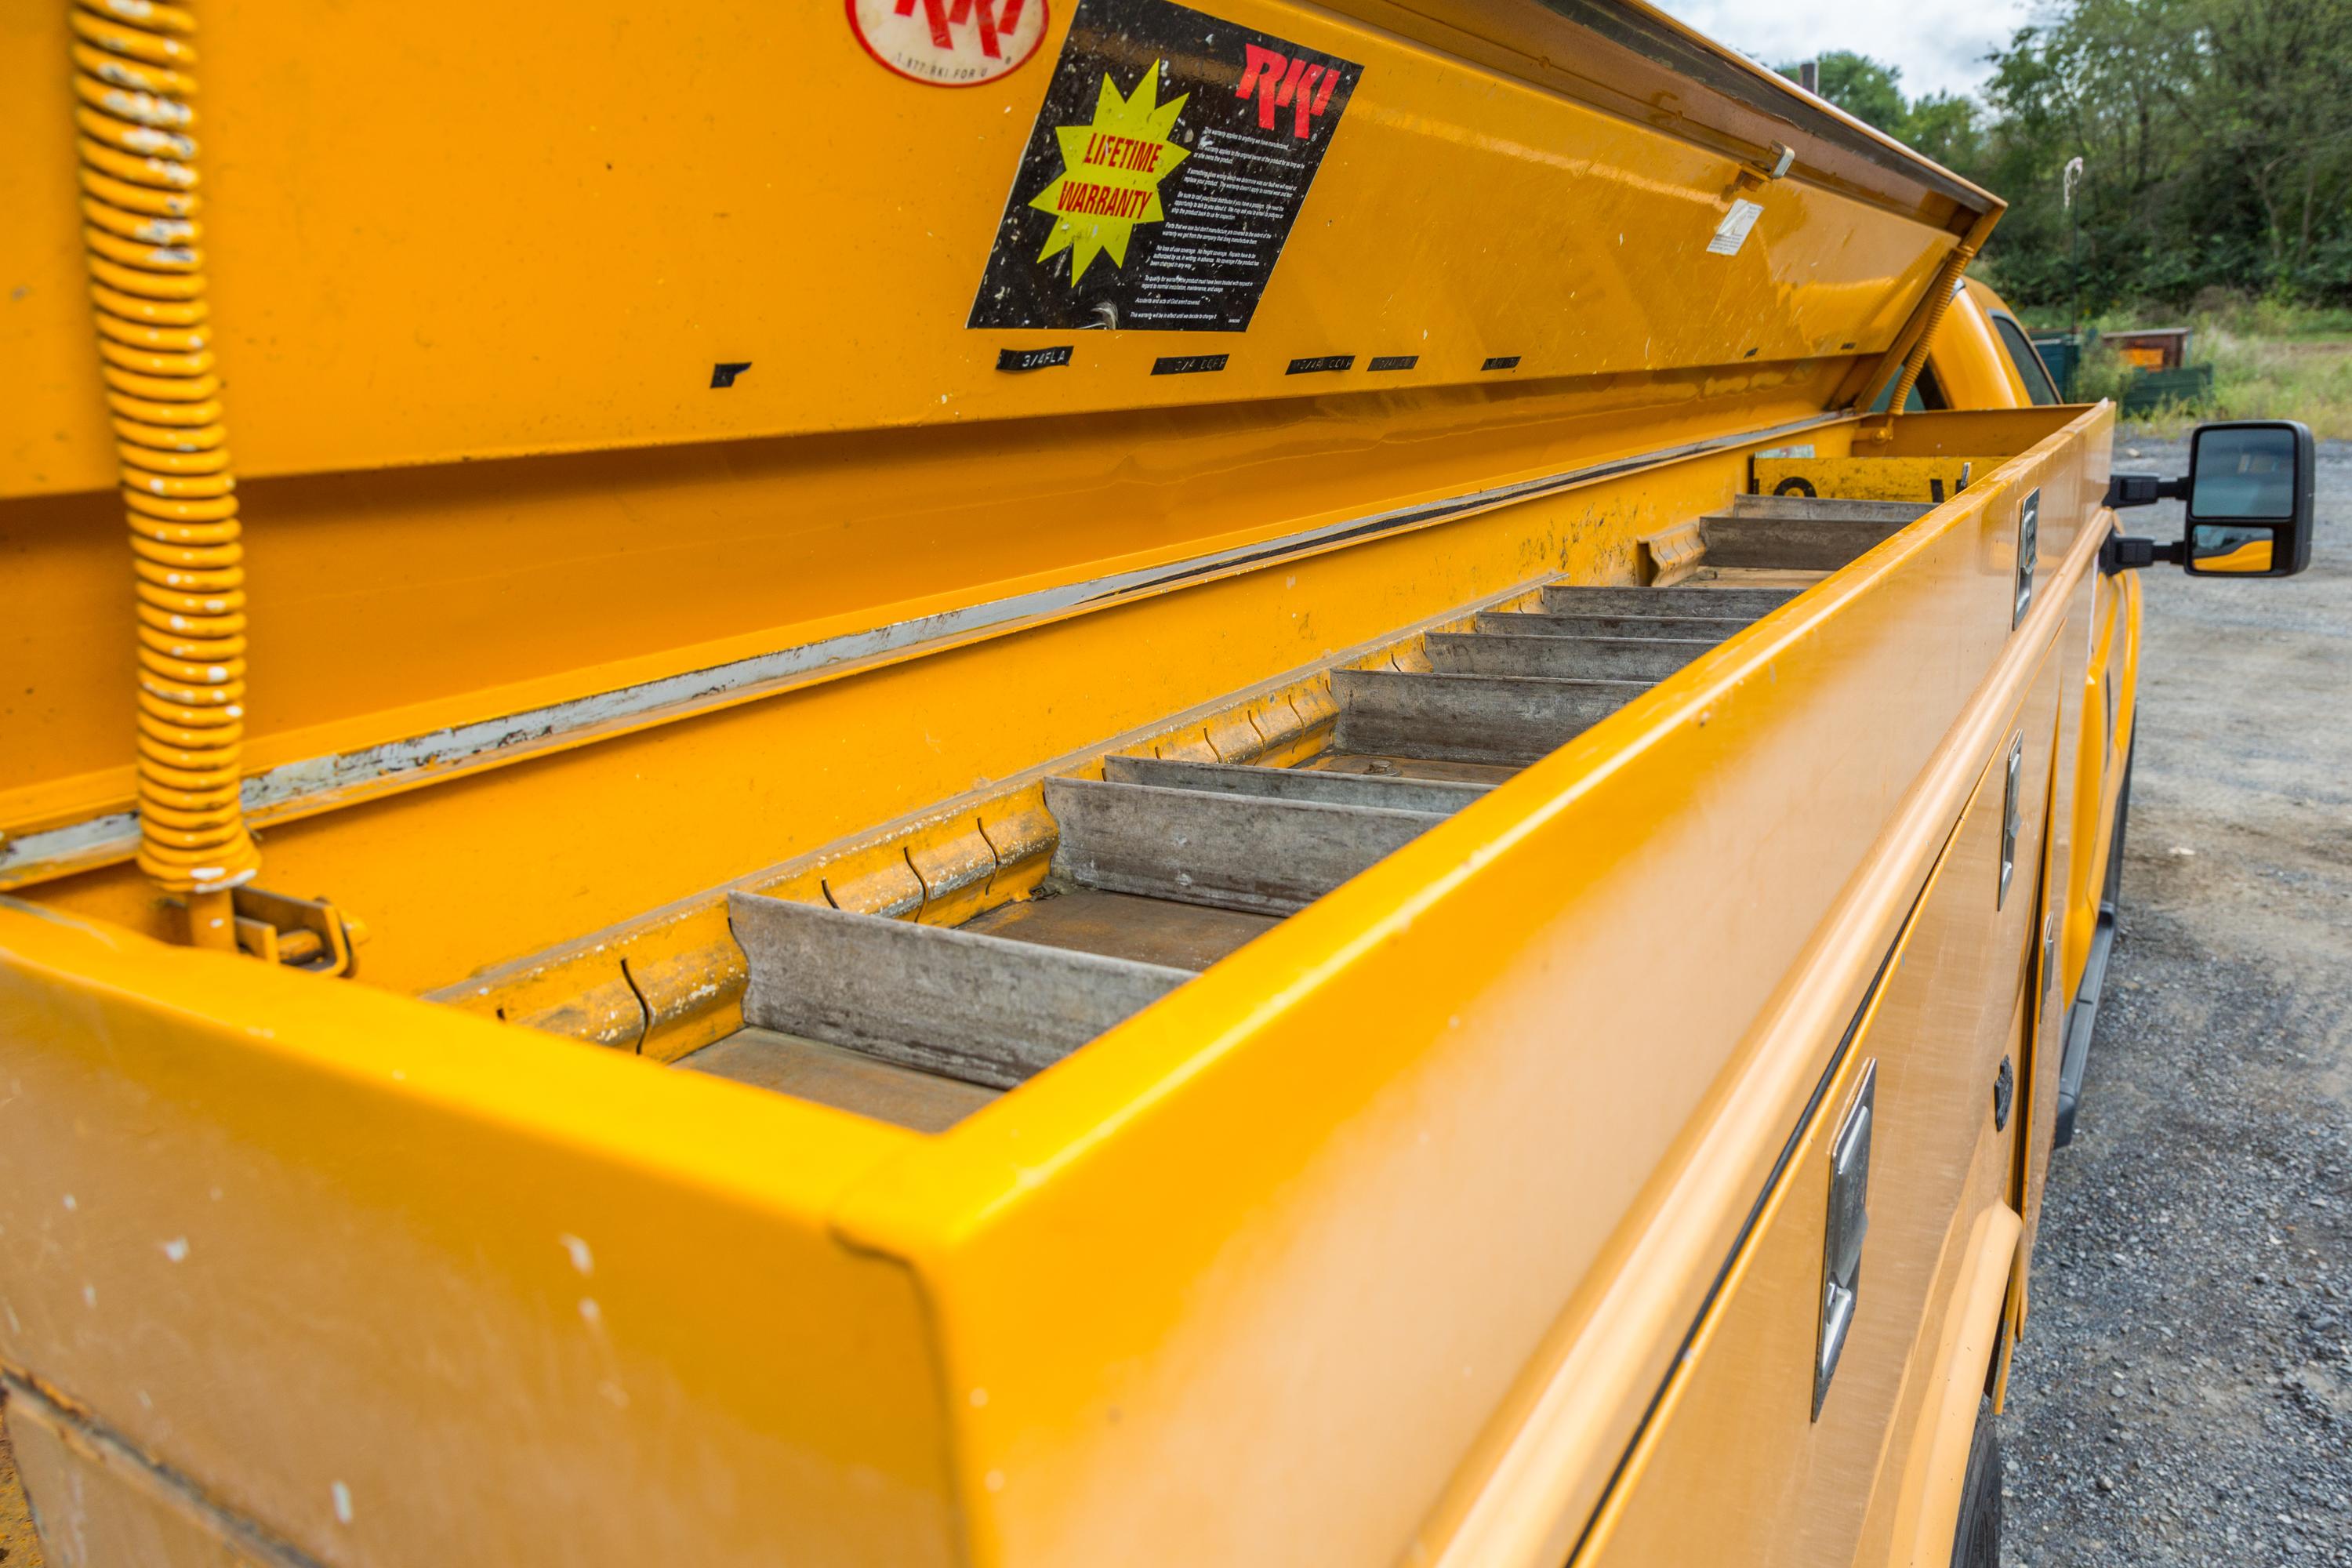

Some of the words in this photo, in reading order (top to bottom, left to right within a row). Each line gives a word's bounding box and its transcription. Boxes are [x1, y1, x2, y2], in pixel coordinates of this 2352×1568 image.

[953, 70, 975, 79] FOR
[1235, 42, 1341, 139] RKI
[1083, 132, 1163, 173] LIFETIME
[1057, 180, 1153, 219] WARRANTY
